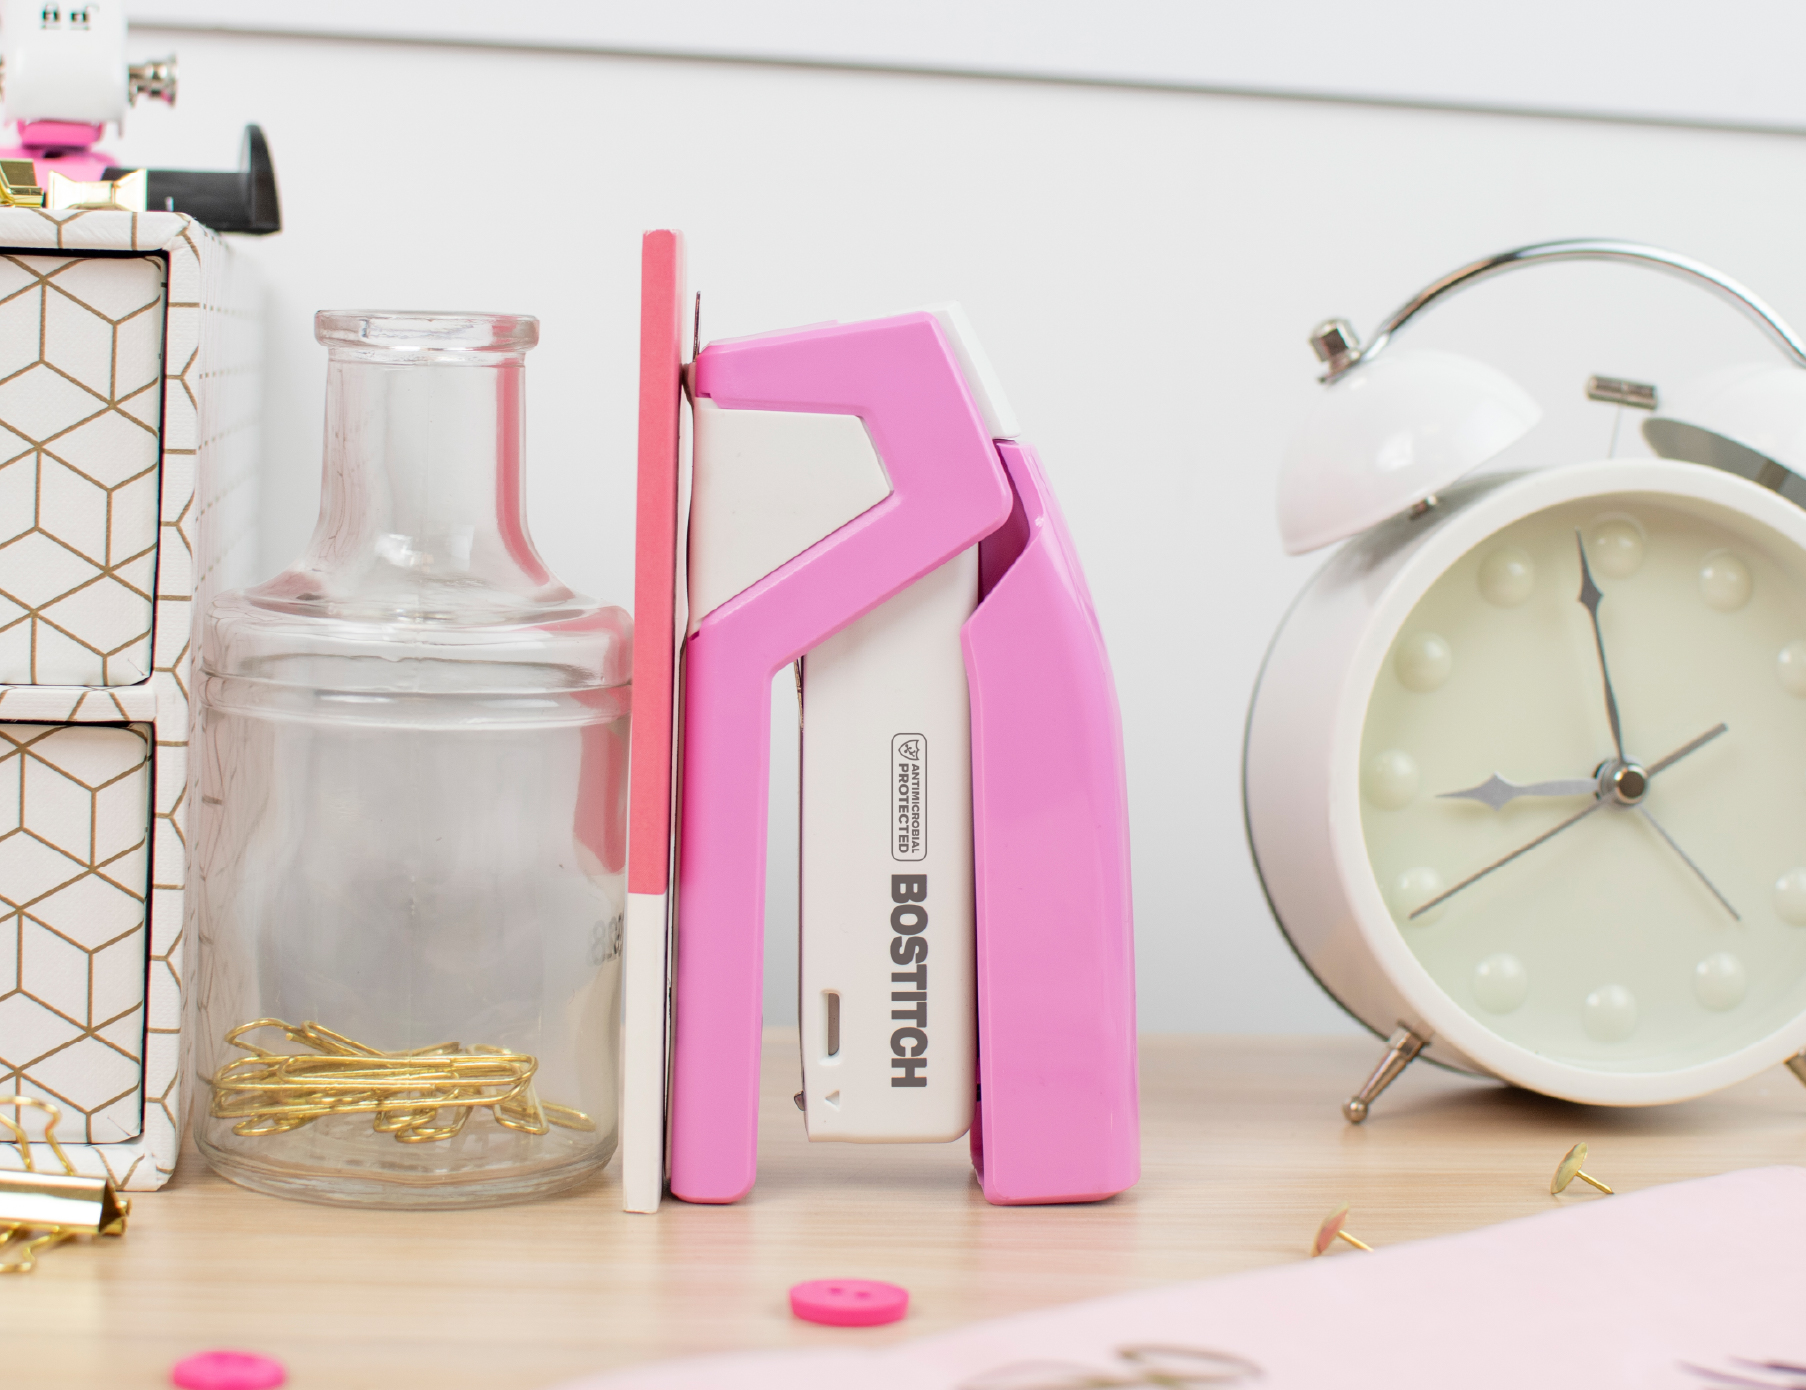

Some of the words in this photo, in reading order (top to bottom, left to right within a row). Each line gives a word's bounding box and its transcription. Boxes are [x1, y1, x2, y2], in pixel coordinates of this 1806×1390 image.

[898, 763, 910, 854] PROTECTED
[911, 763, 920, 854] ANTIMICROBIAL
[890, 873, 929, 1088] BOSTITCH
